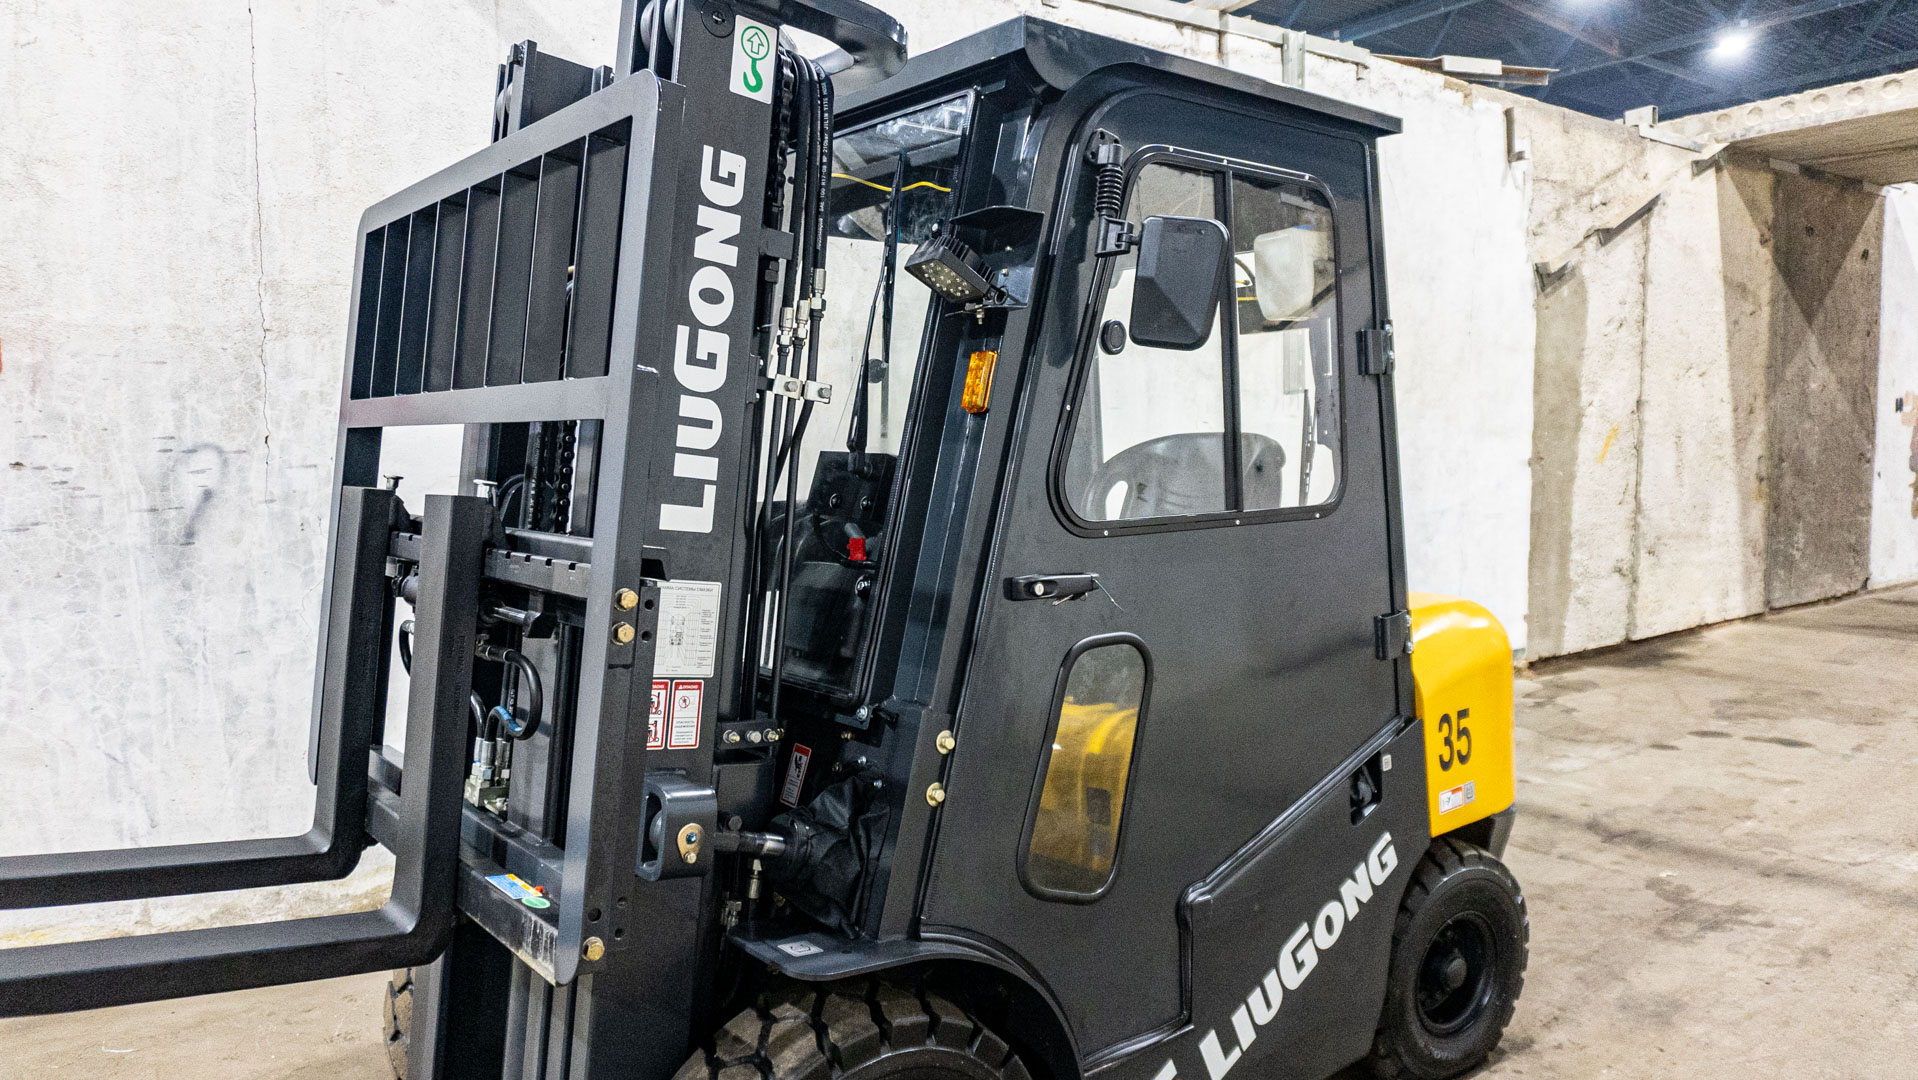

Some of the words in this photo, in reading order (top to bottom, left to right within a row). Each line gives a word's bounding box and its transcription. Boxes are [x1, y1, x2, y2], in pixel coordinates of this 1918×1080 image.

[659, 144, 747, 533] LIUGONG
[1438, 708, 1472, 772] 35
[1198, 832, 1399, 1080] LIUGONG
